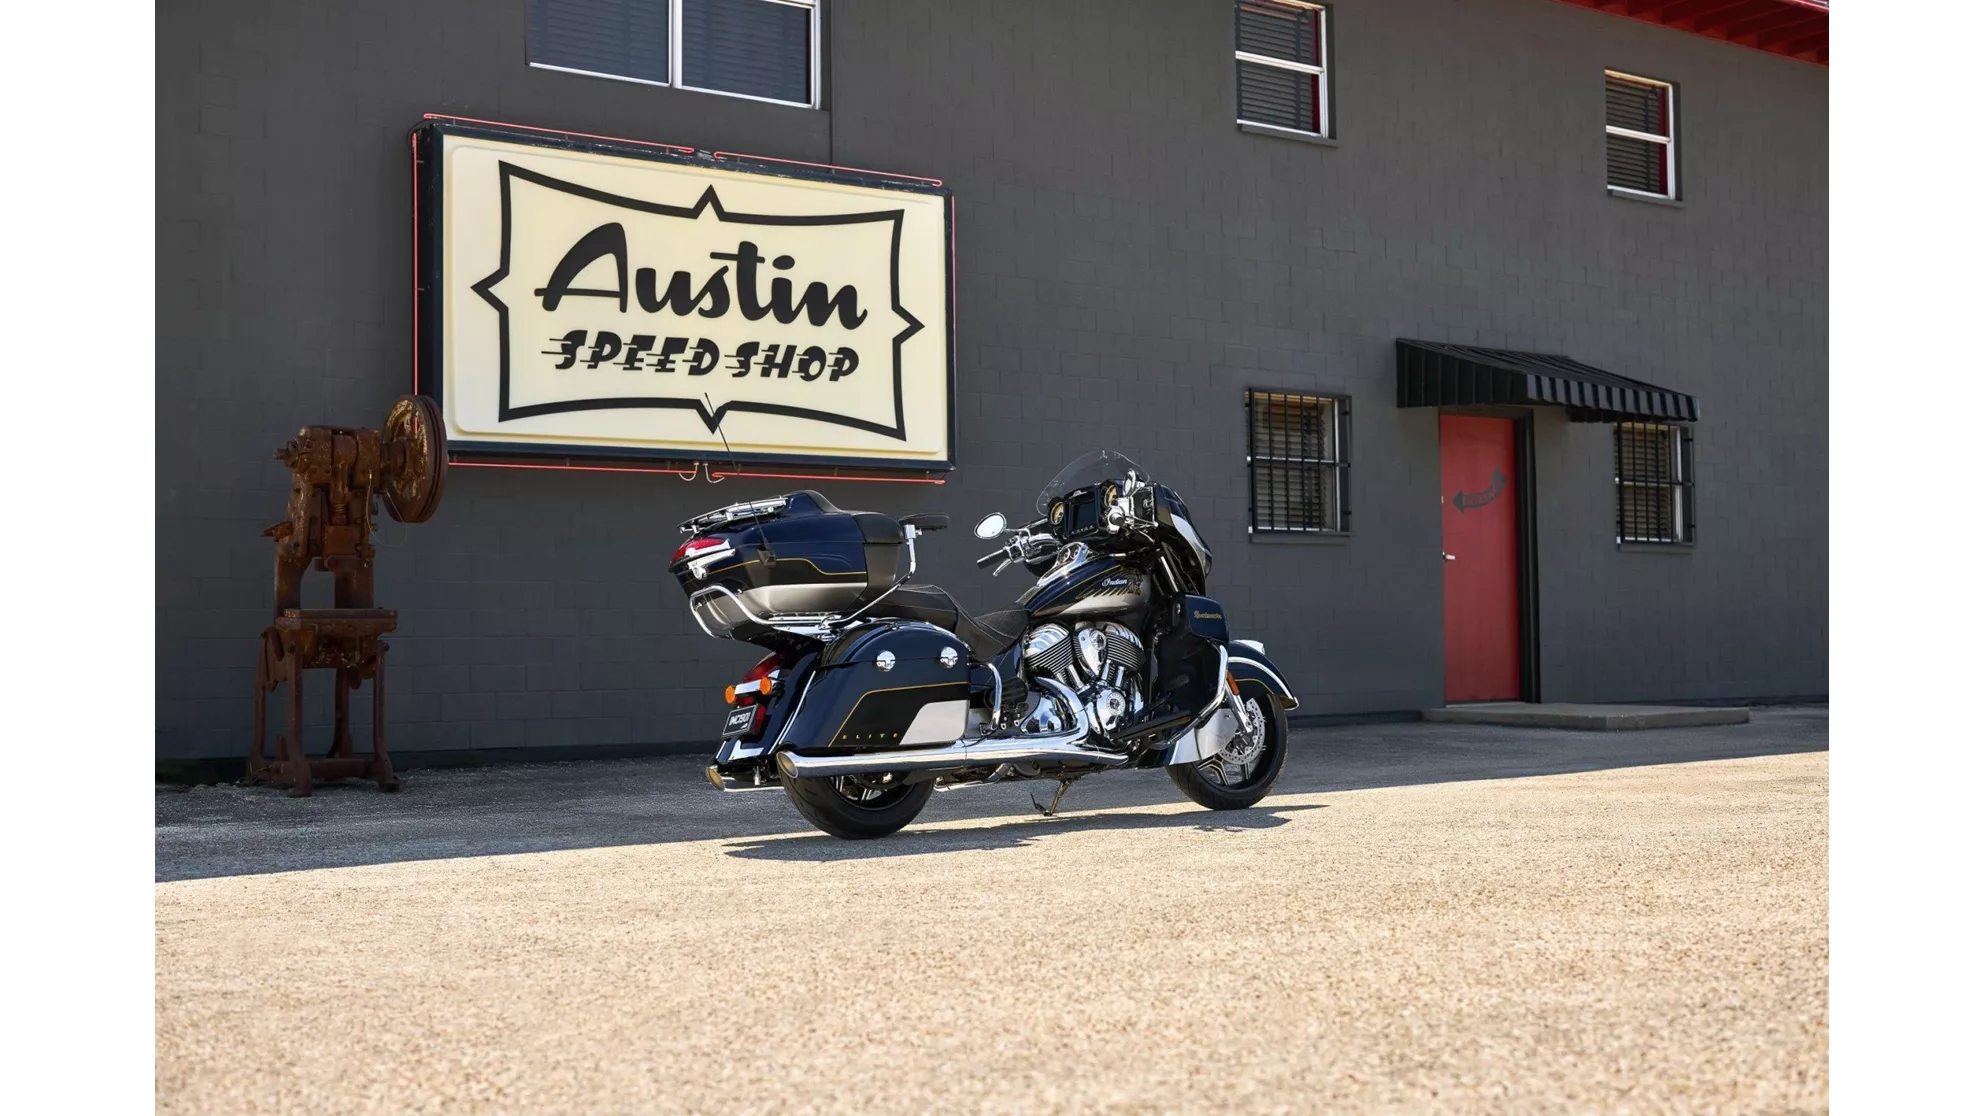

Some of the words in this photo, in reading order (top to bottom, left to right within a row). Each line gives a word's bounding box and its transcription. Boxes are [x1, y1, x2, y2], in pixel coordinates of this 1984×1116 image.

[534, 222, 868, 331] Austin
[541, 329, 720, 376] SPEED
[724, 341, 860, 382] SHOP
[1101, 577, 1127, 587] Indian
